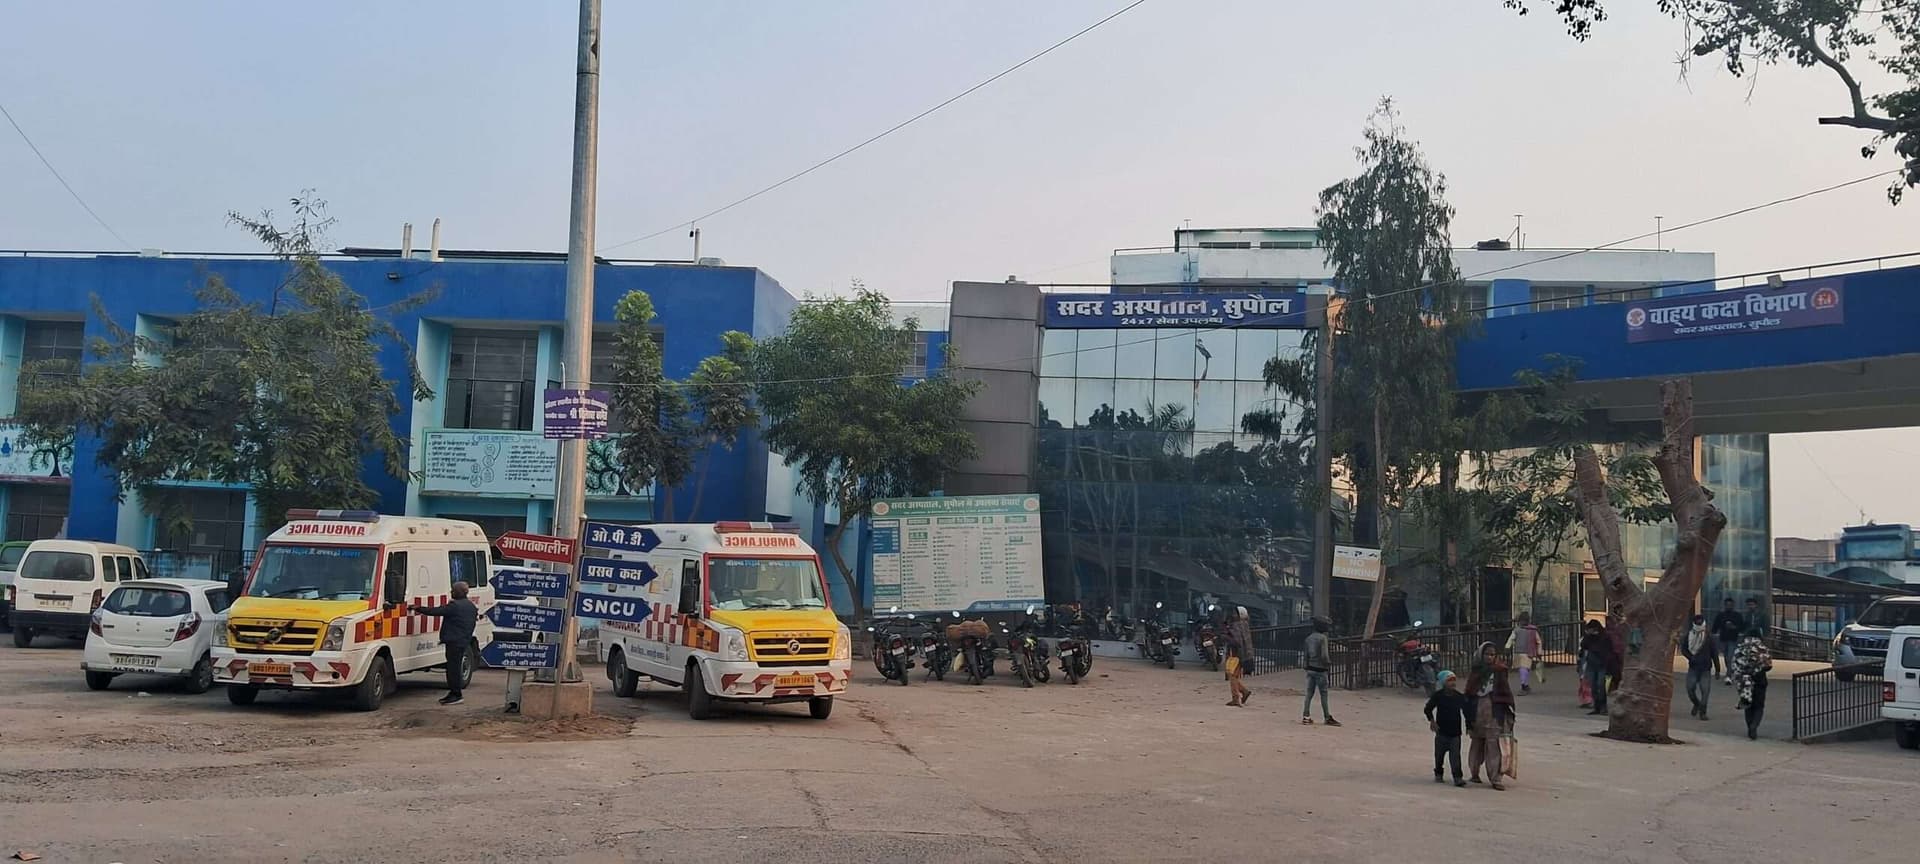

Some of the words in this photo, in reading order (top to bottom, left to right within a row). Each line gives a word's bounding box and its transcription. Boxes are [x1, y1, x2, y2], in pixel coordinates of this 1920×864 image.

[1057, 300, 1105, 316] सदर
[1222, 293, 1293, 320] सुपौल
[1700, 300, 1742, 320] कक्ष
[1156, 315, 1179, 325] सेवा
[1182, 317, 1224, 325] उपलब्ध
[1674, 326, 1697, 335] सदर
[502, 536, 570, 556] आपातकालीन
[591, 527, 646, 547] ओ.पी.डी.
[587, 565, 615, 579] प्रसव
[619, 567, 643, 581] कक्ष
[582, 598, 636, 617] SNCU
